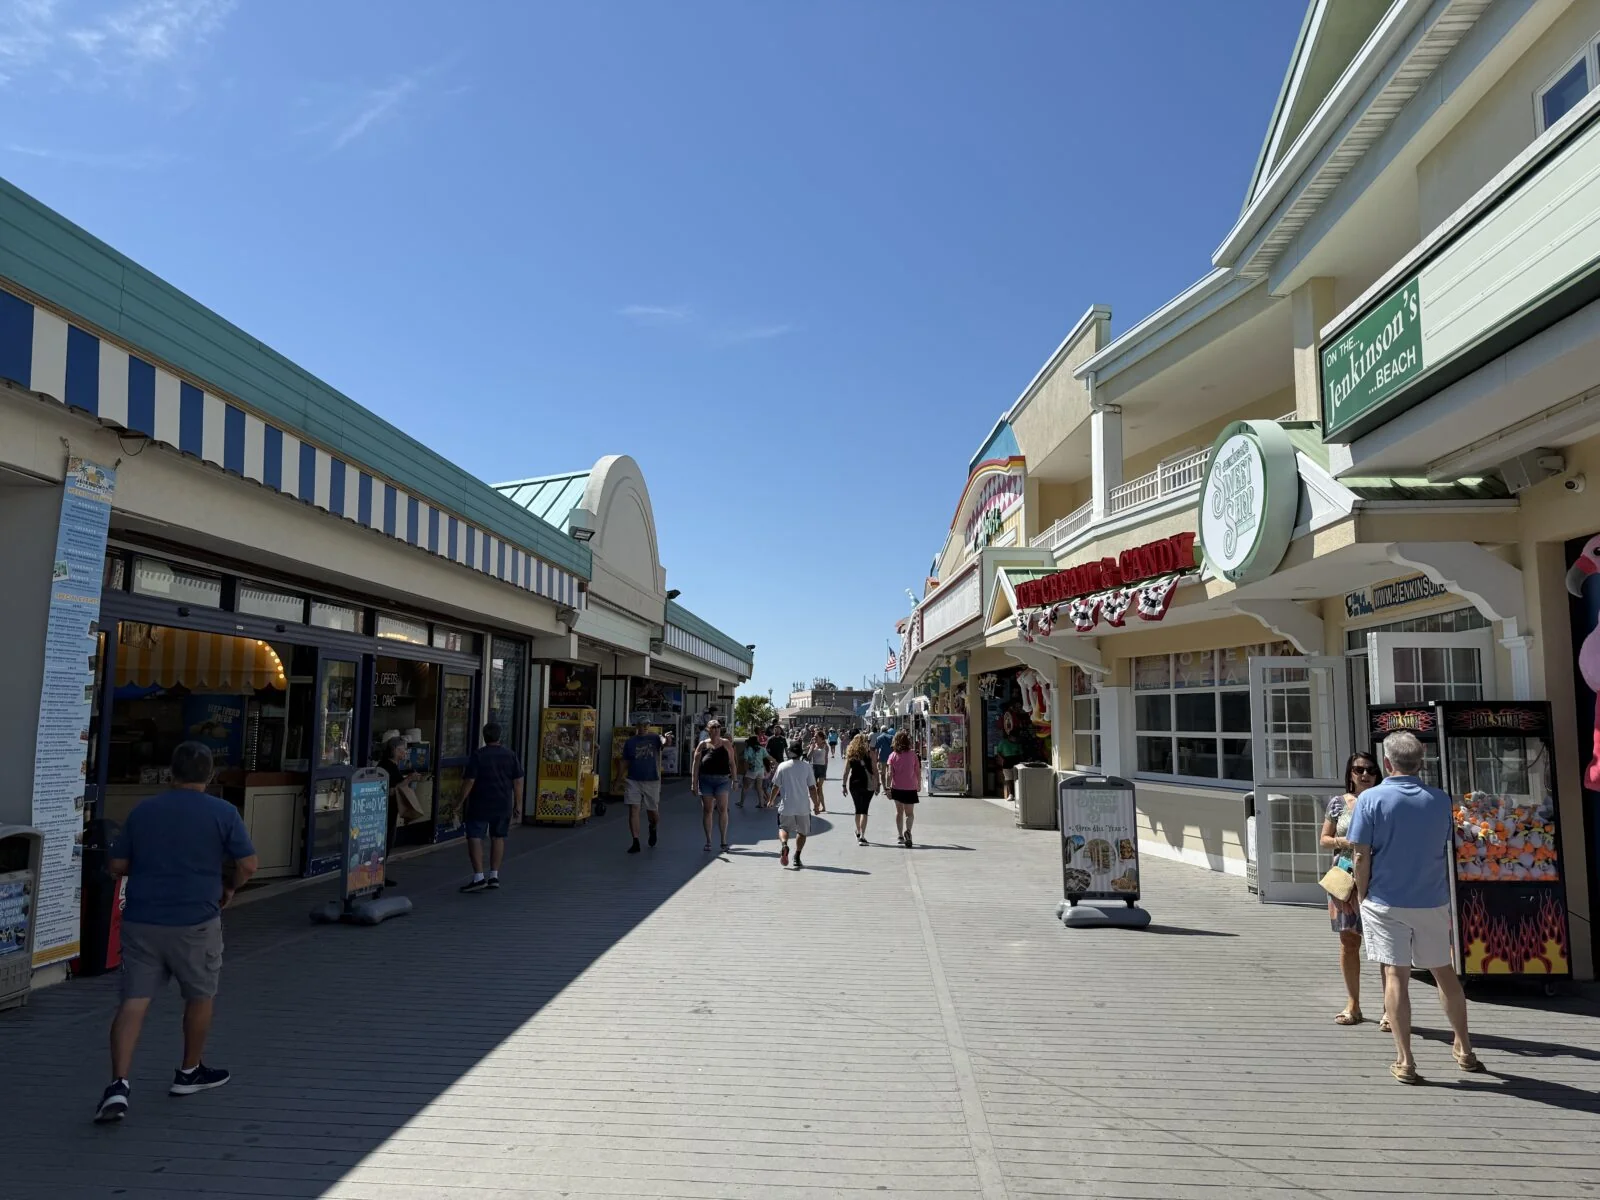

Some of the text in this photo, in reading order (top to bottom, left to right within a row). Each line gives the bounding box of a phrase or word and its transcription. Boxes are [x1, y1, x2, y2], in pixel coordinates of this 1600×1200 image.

[1326, 350, 1338, 368] ON
[1328, 289, 1418, 429] Jenkinson's
[1015, 532, 1196, 609] ICE CREAM & CANDY
[1179, 645, 1260, 666] OPEN
[1180, 668, 1239, 689] YEA
[1387, 713, 1420, 729] HOT STUFF
[1470, 712, 1522, 730] HOT STUFF
[352, 798, 366, 813] DNE
[372, 796, 386, 811] DVE
[0, 897, 24, 909] QUARIUM
